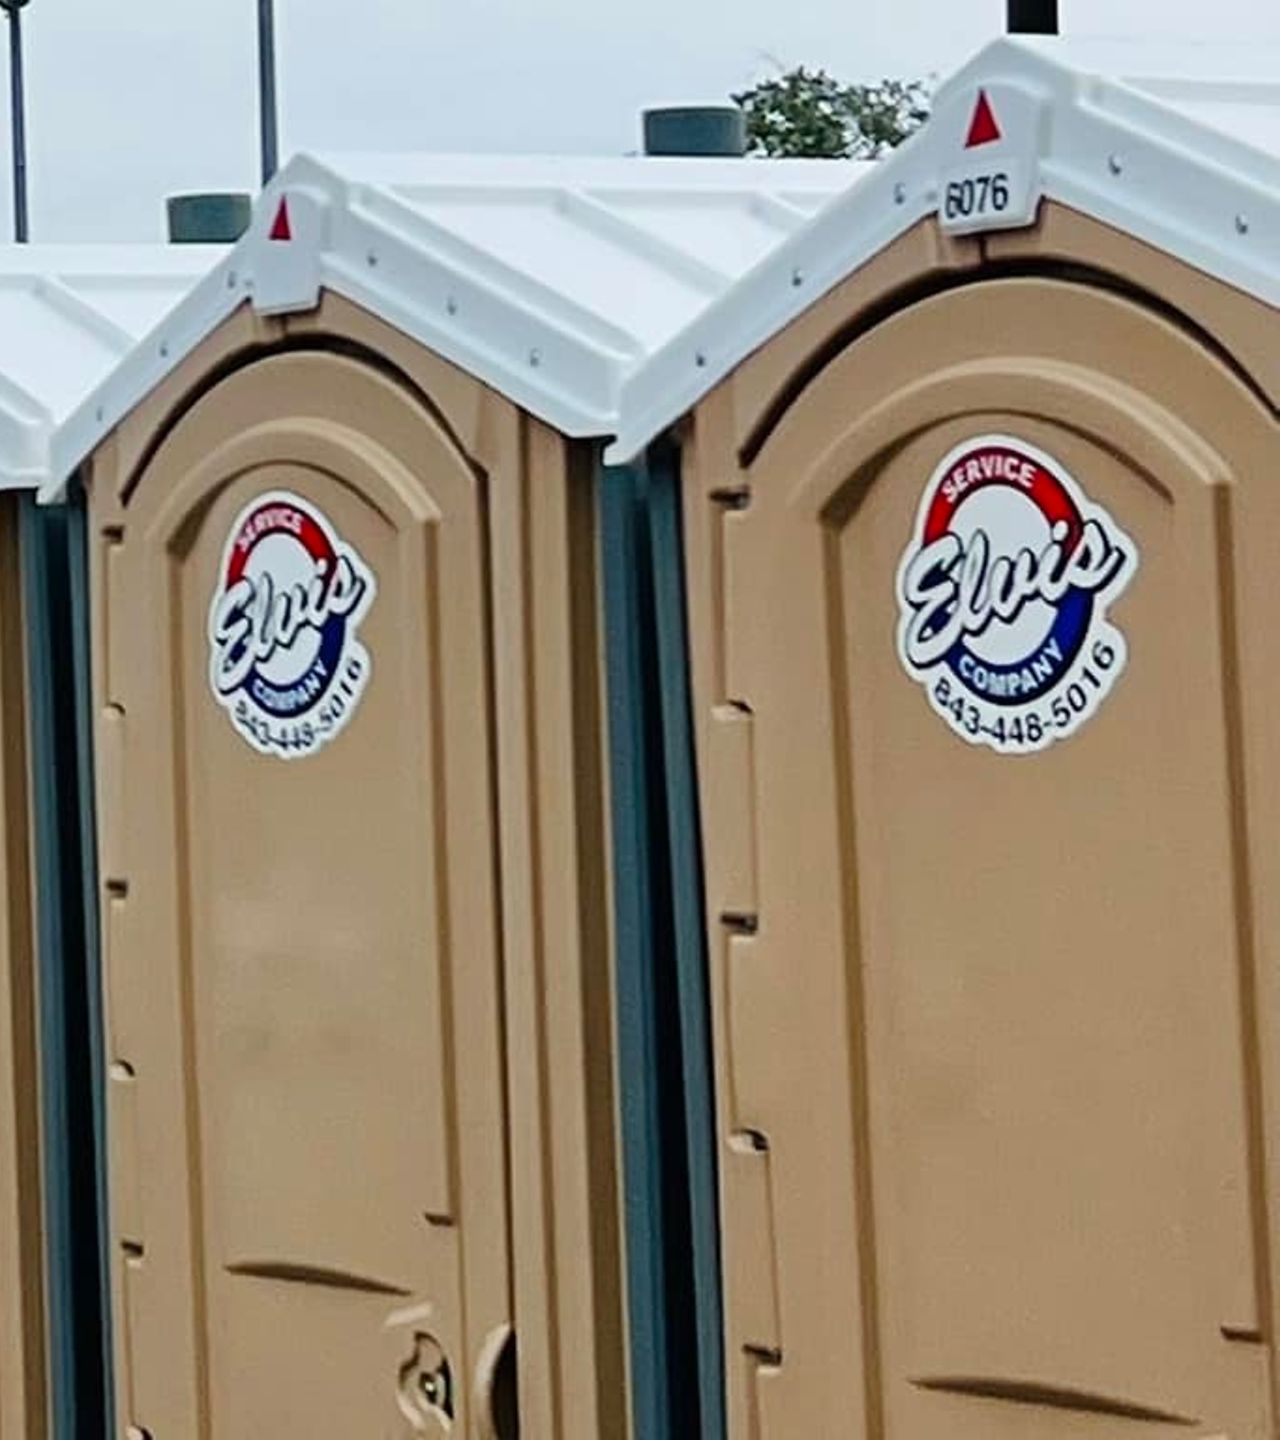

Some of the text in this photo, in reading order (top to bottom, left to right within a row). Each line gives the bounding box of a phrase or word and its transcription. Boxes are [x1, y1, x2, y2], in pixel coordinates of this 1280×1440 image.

[945, 172, 1008, 220] 6076
[941, 455, 1038, 504] SERVICE
[238, 506, 305, 553] SERVICE
[904, 517, 1127, 670] Elvis
[215, 554, 367, 696] Elvis
[933, 640, 1117, 744] 843-448-5016
[957, 636, 1064, 698] COMPANY
